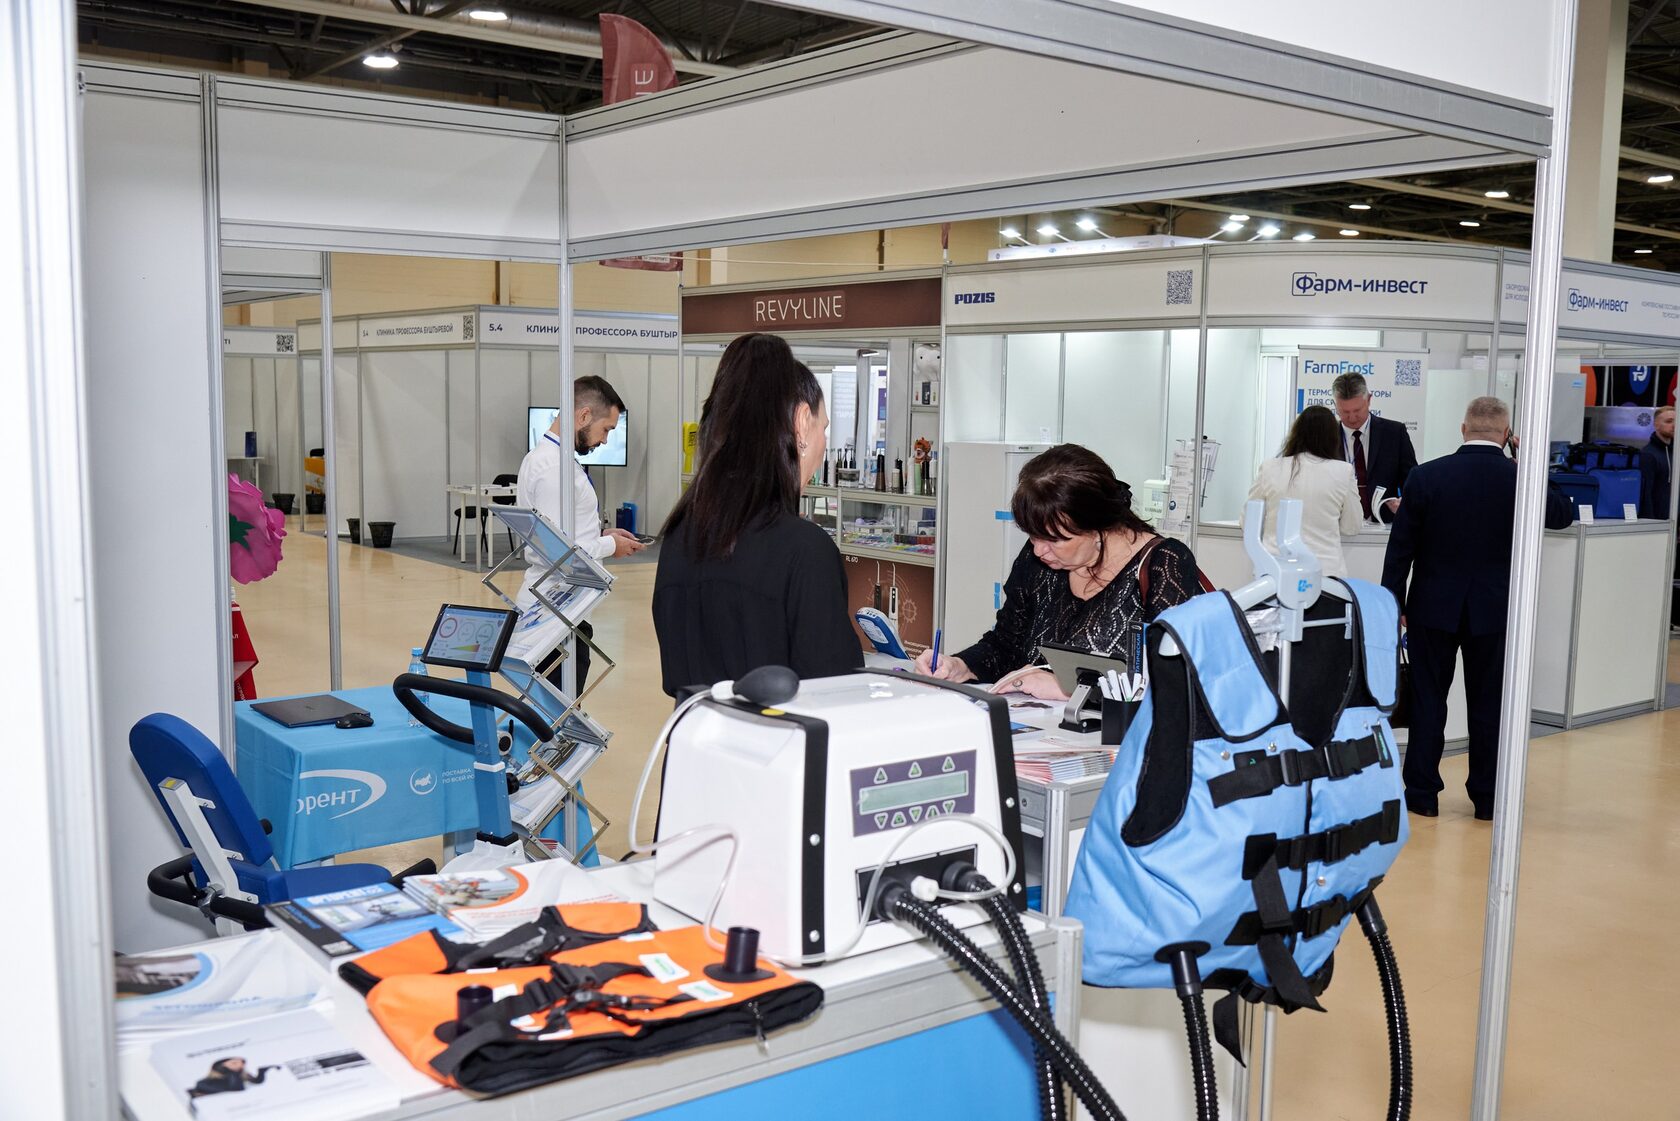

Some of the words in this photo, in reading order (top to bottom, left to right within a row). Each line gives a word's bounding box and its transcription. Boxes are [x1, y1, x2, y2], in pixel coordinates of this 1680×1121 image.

[1295, 274, 1429, 294] Фарм-инвест
[954, 292, 995, 305] POZIS
[1569, 290, 1629, 313] Фарм-инвест
[755, 295, 843, 322] REVYLINE
[395, 326, 423, 335] ПРОФЕССОРА
[423, 323, 453, 334] БУШТЫРЕВОЙ
[489, 323, 503, 332] 5.4
[526, 324, 560, 334] КЛИНИ
[575, 326, 638, 337] ПРОФЕССОРА
[640, 329, 678, 339] БУШТЫР
[1304, 360, 1375, 375] FarmFrost
